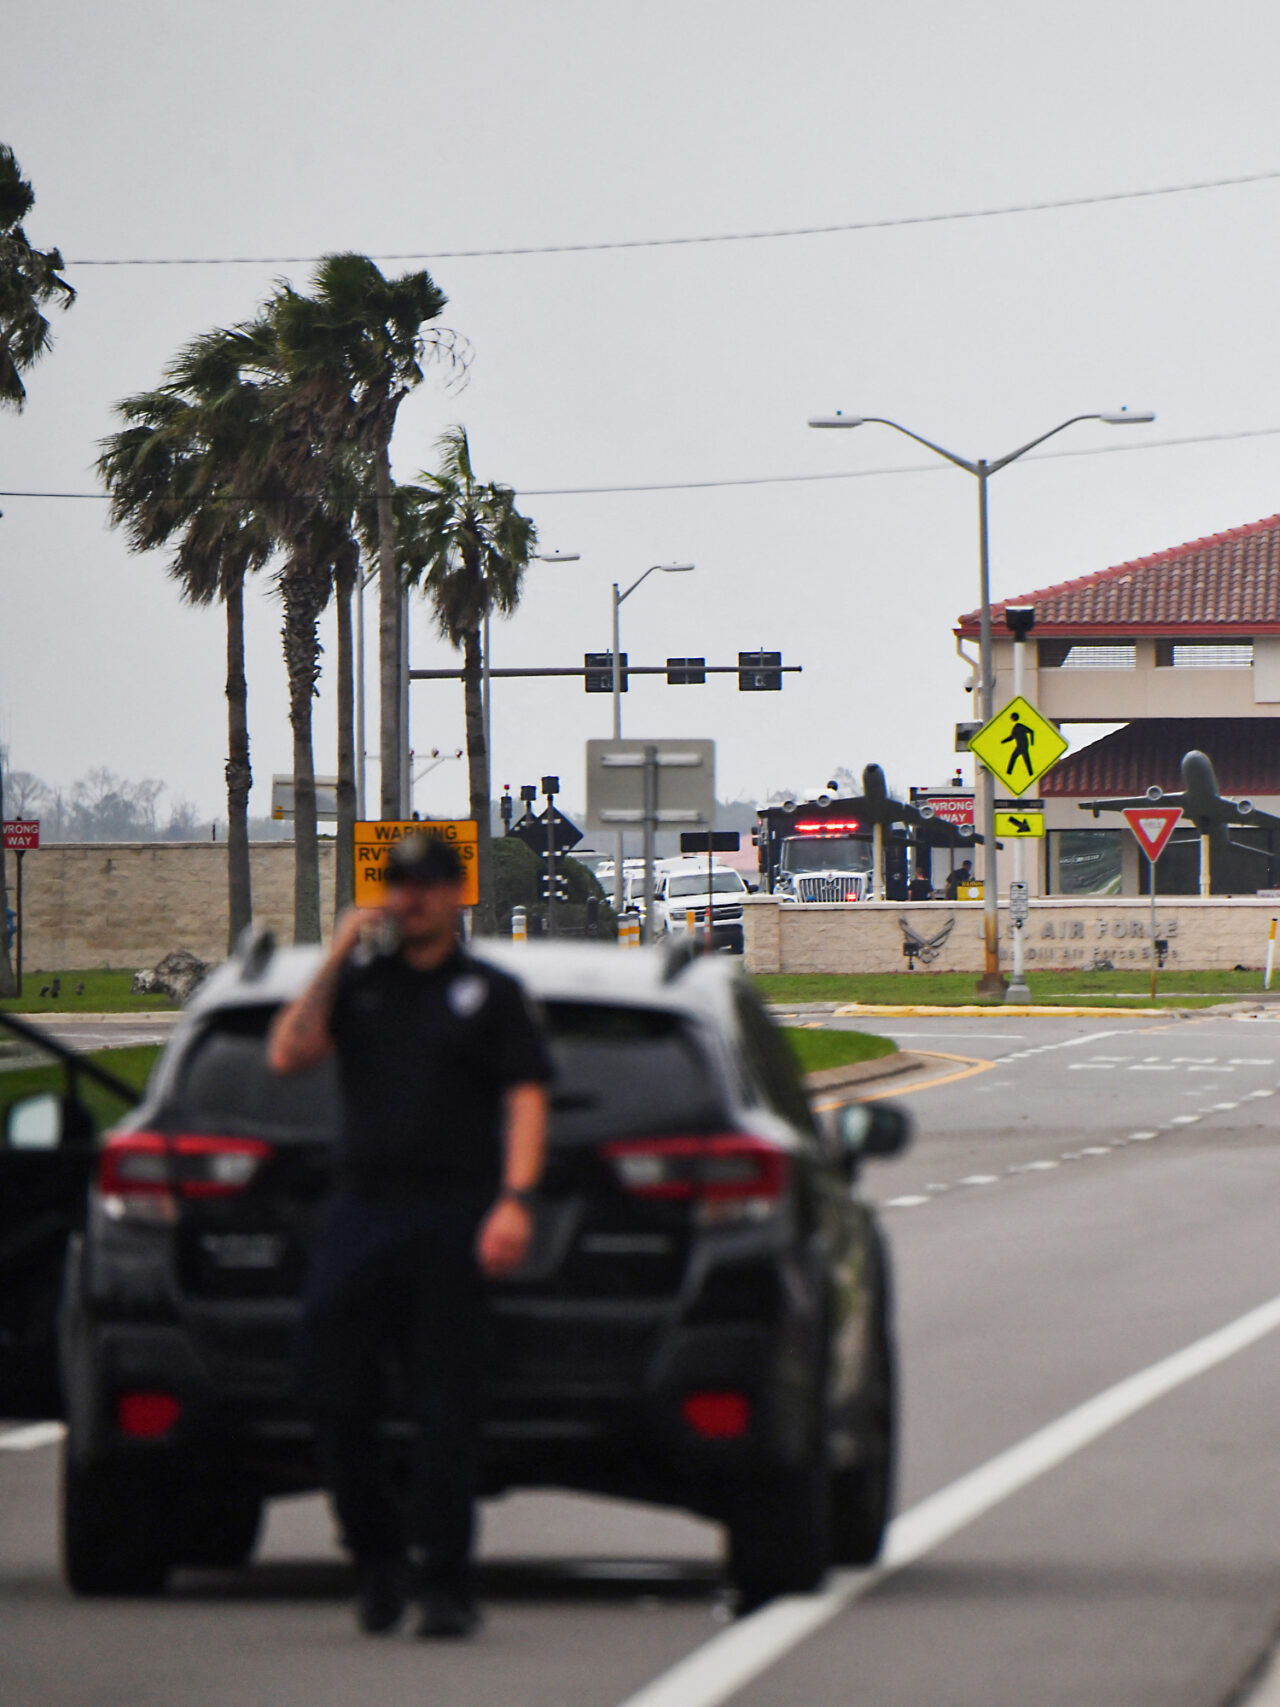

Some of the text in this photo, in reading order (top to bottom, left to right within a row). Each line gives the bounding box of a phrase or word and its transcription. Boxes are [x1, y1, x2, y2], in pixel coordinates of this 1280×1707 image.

[930, 801, 974, 811] WRONG
[939, 813, 966, 822] WAY
[7, 836, 31, 846] WAY
[1041, 920, 1085, 939] AIR
[1095, 918, 1178, 939] FORCE
